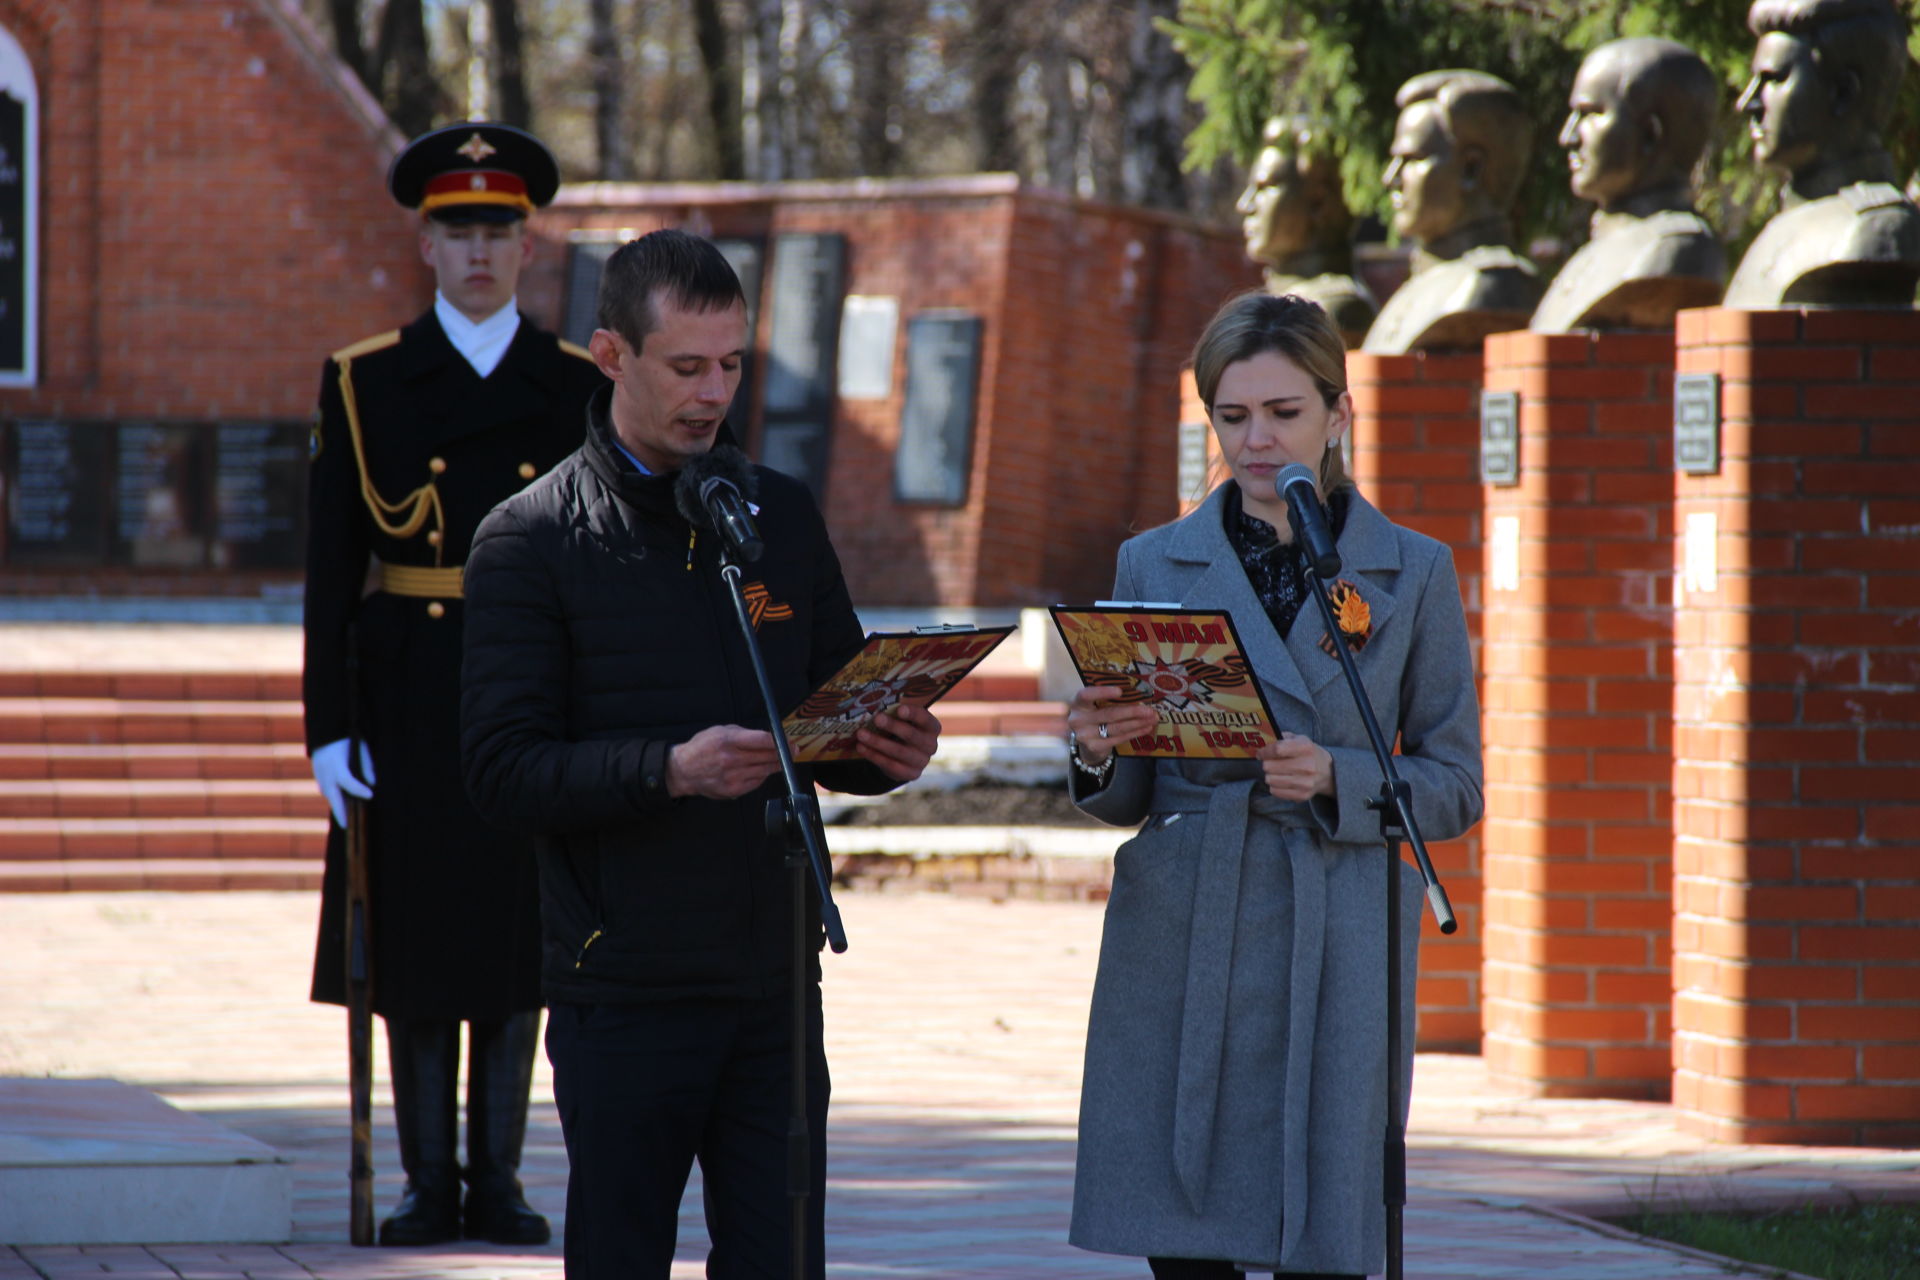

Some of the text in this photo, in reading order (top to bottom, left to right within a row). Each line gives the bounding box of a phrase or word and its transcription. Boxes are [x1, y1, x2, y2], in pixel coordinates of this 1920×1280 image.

[1123, 622, 1227, 645] 9 МАЯ
[1173, 711, 1261, 728] ПОБЕДЫ
[1199, 731, 1266, 748] 1945
